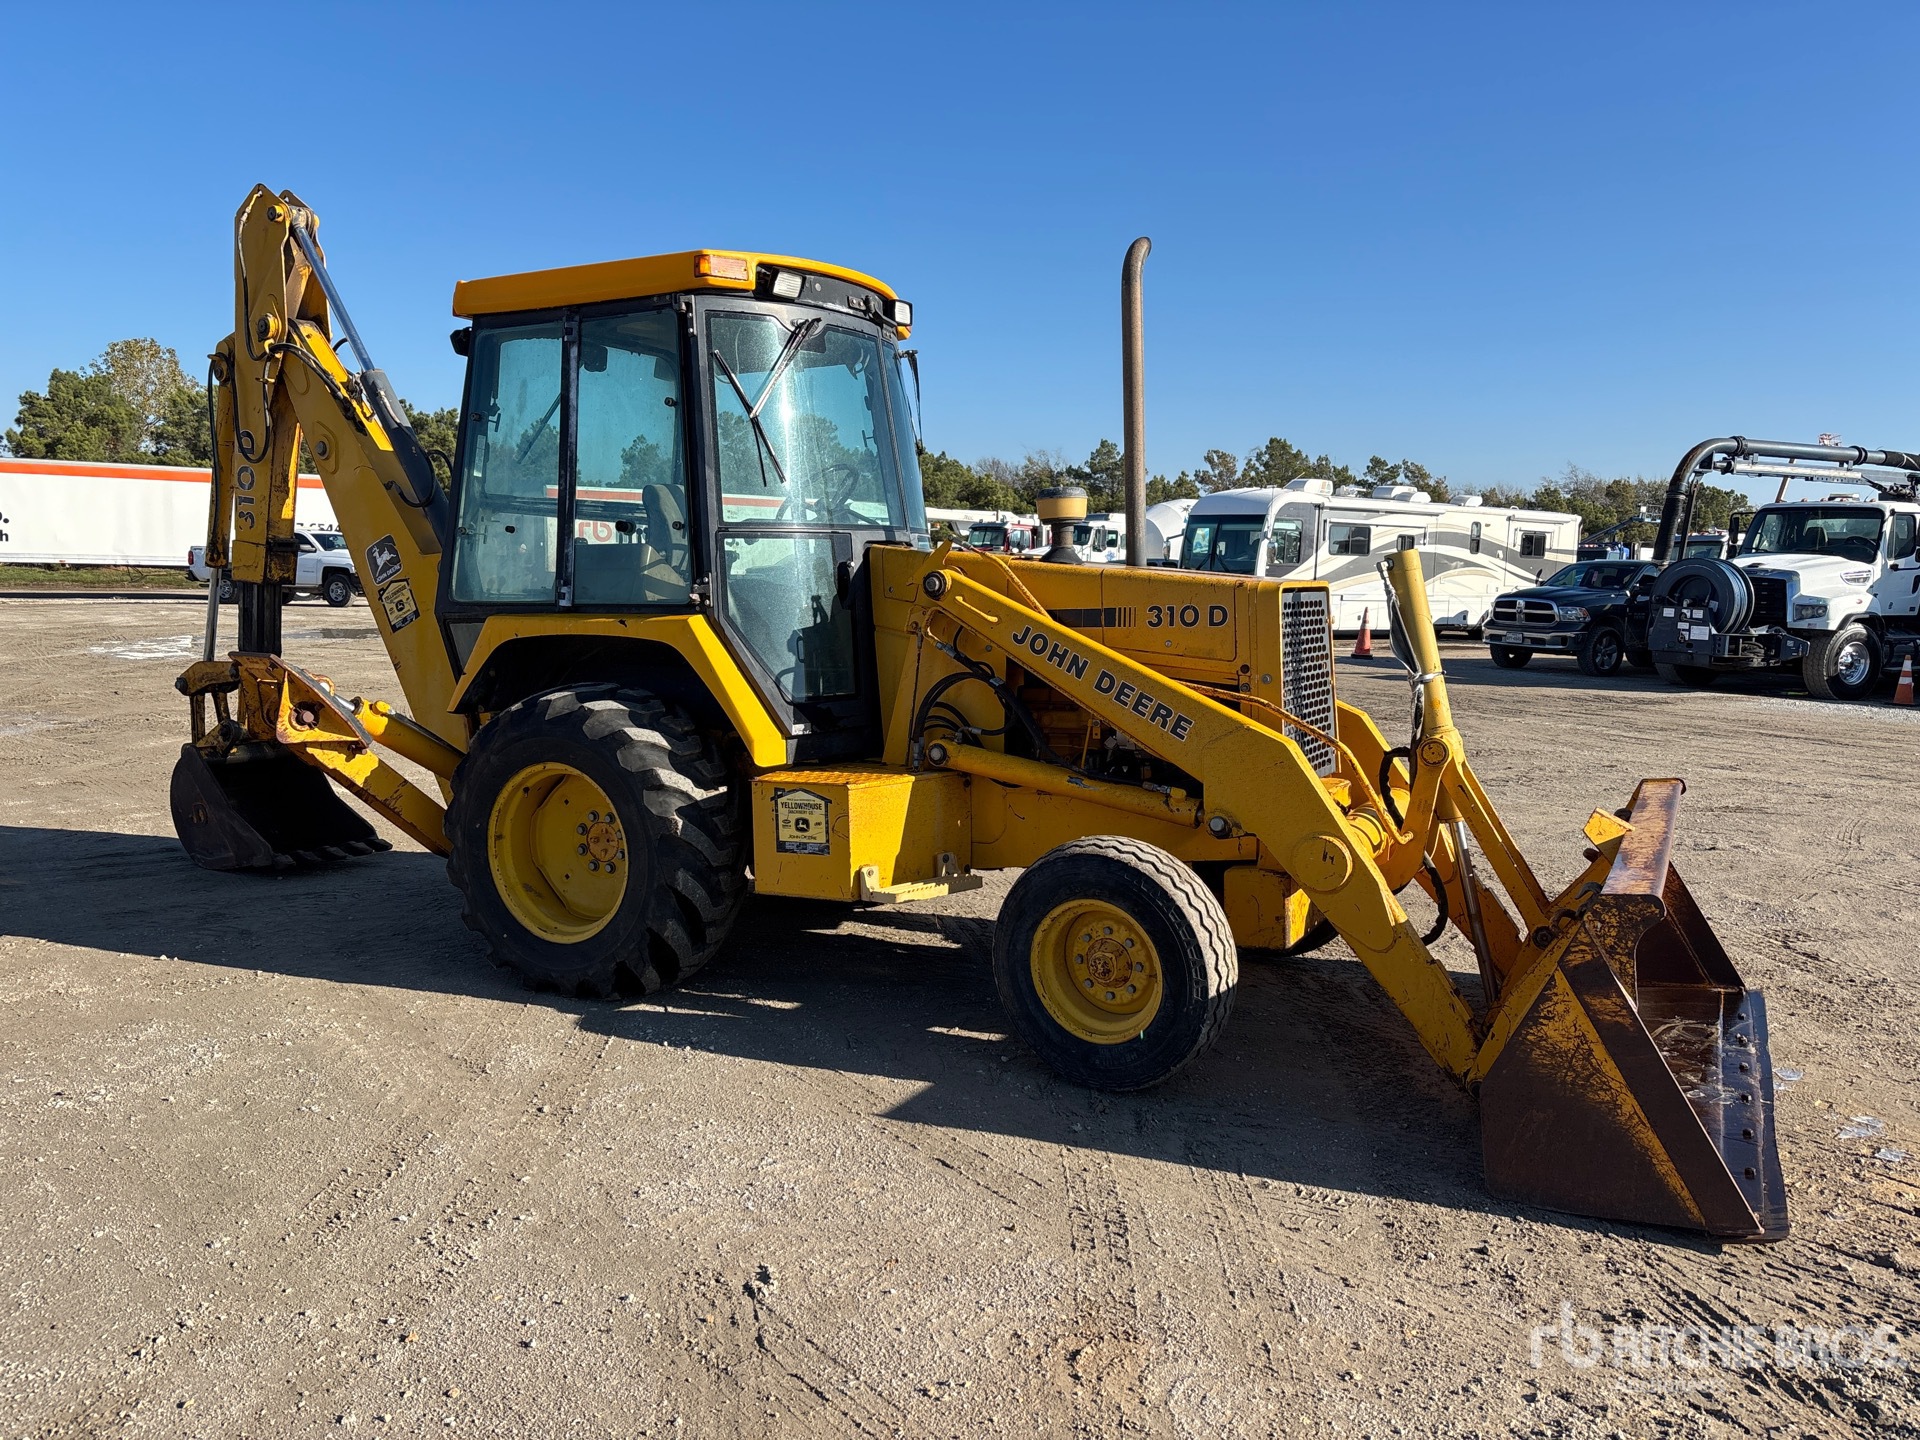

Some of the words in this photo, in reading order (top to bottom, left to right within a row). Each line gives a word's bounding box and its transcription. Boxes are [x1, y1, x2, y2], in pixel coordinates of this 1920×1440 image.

[1147, 604, 1200, 629] 310
[1208, 604, 1230, 628] D
[1012, 626, 1090, 681] JOHN
[1094, 669, 1194, 741] DEERE
[781, 802, 822, 810] YELLOWHOUSE
